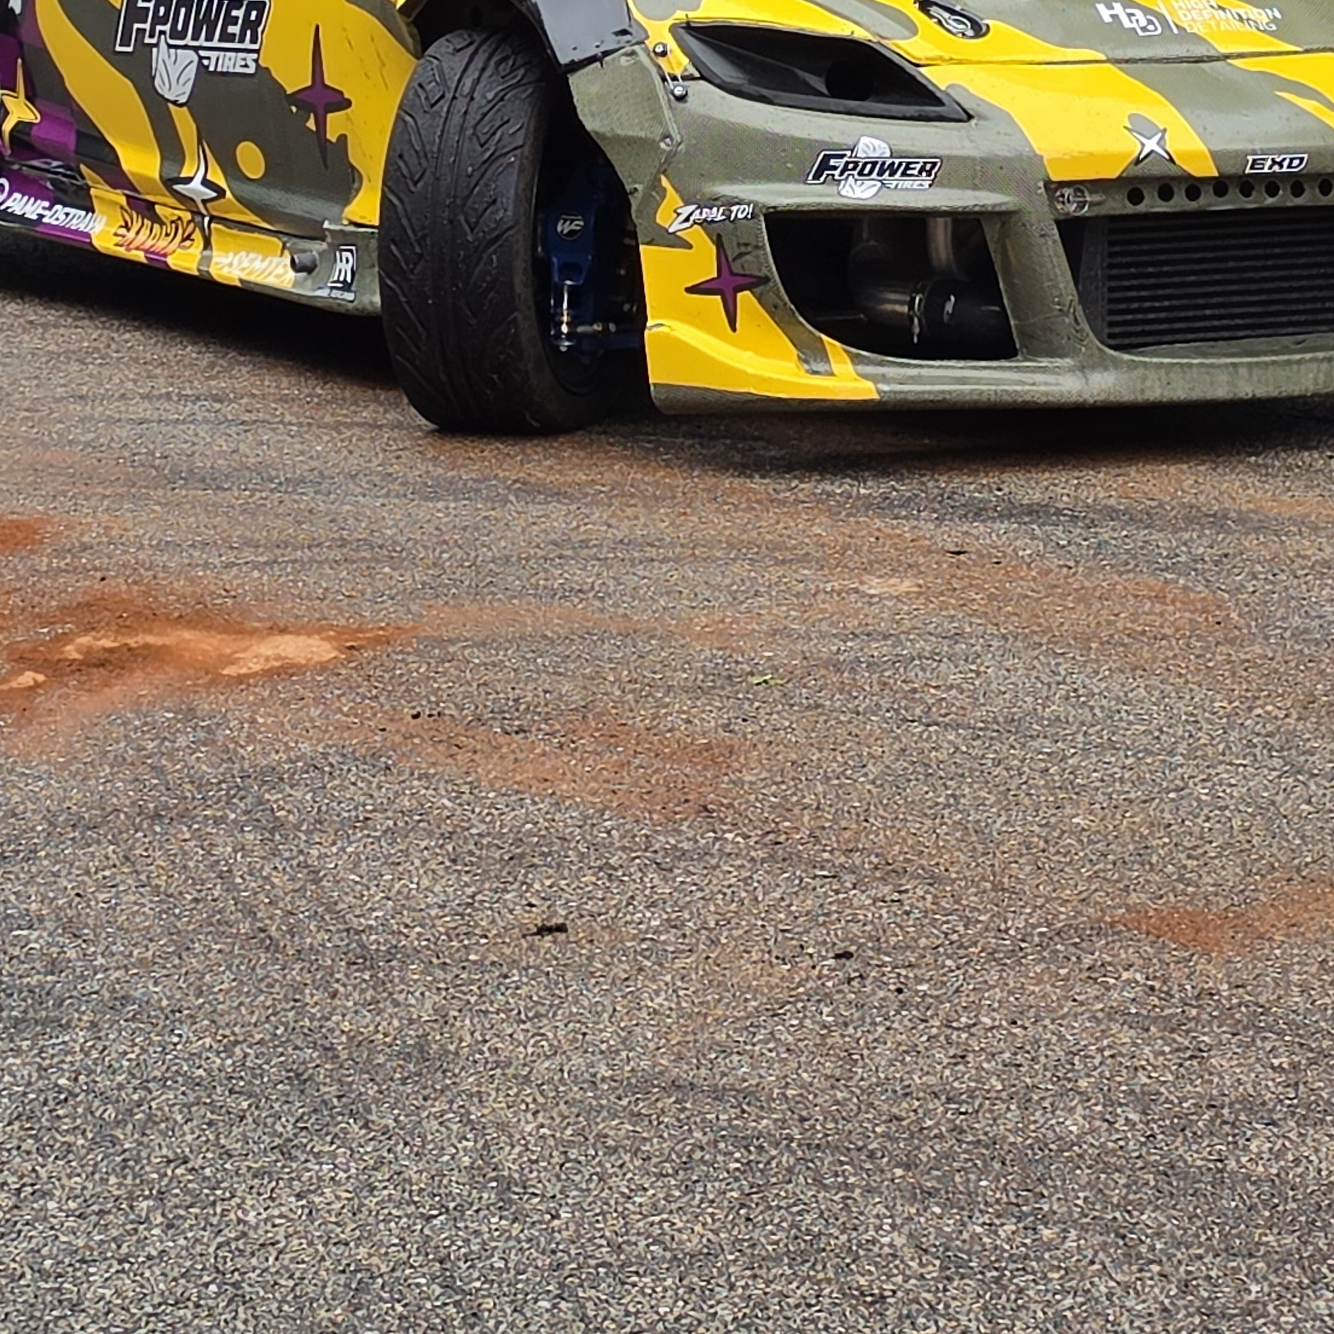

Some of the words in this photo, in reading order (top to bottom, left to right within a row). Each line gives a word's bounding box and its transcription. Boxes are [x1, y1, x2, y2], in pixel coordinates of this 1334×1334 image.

[1175, 6, 1282, 22] DEFINITION
[1183, 18, 1277, 34] DETAILING
[198, 50, 259, 74] TIRES
[1245, 154, 1309, 174] EXD
[883, 180, 934, 190] TIRES
[667, 204, 728, 234] ZAPAL
[729, 203, 755, 221] TO!
